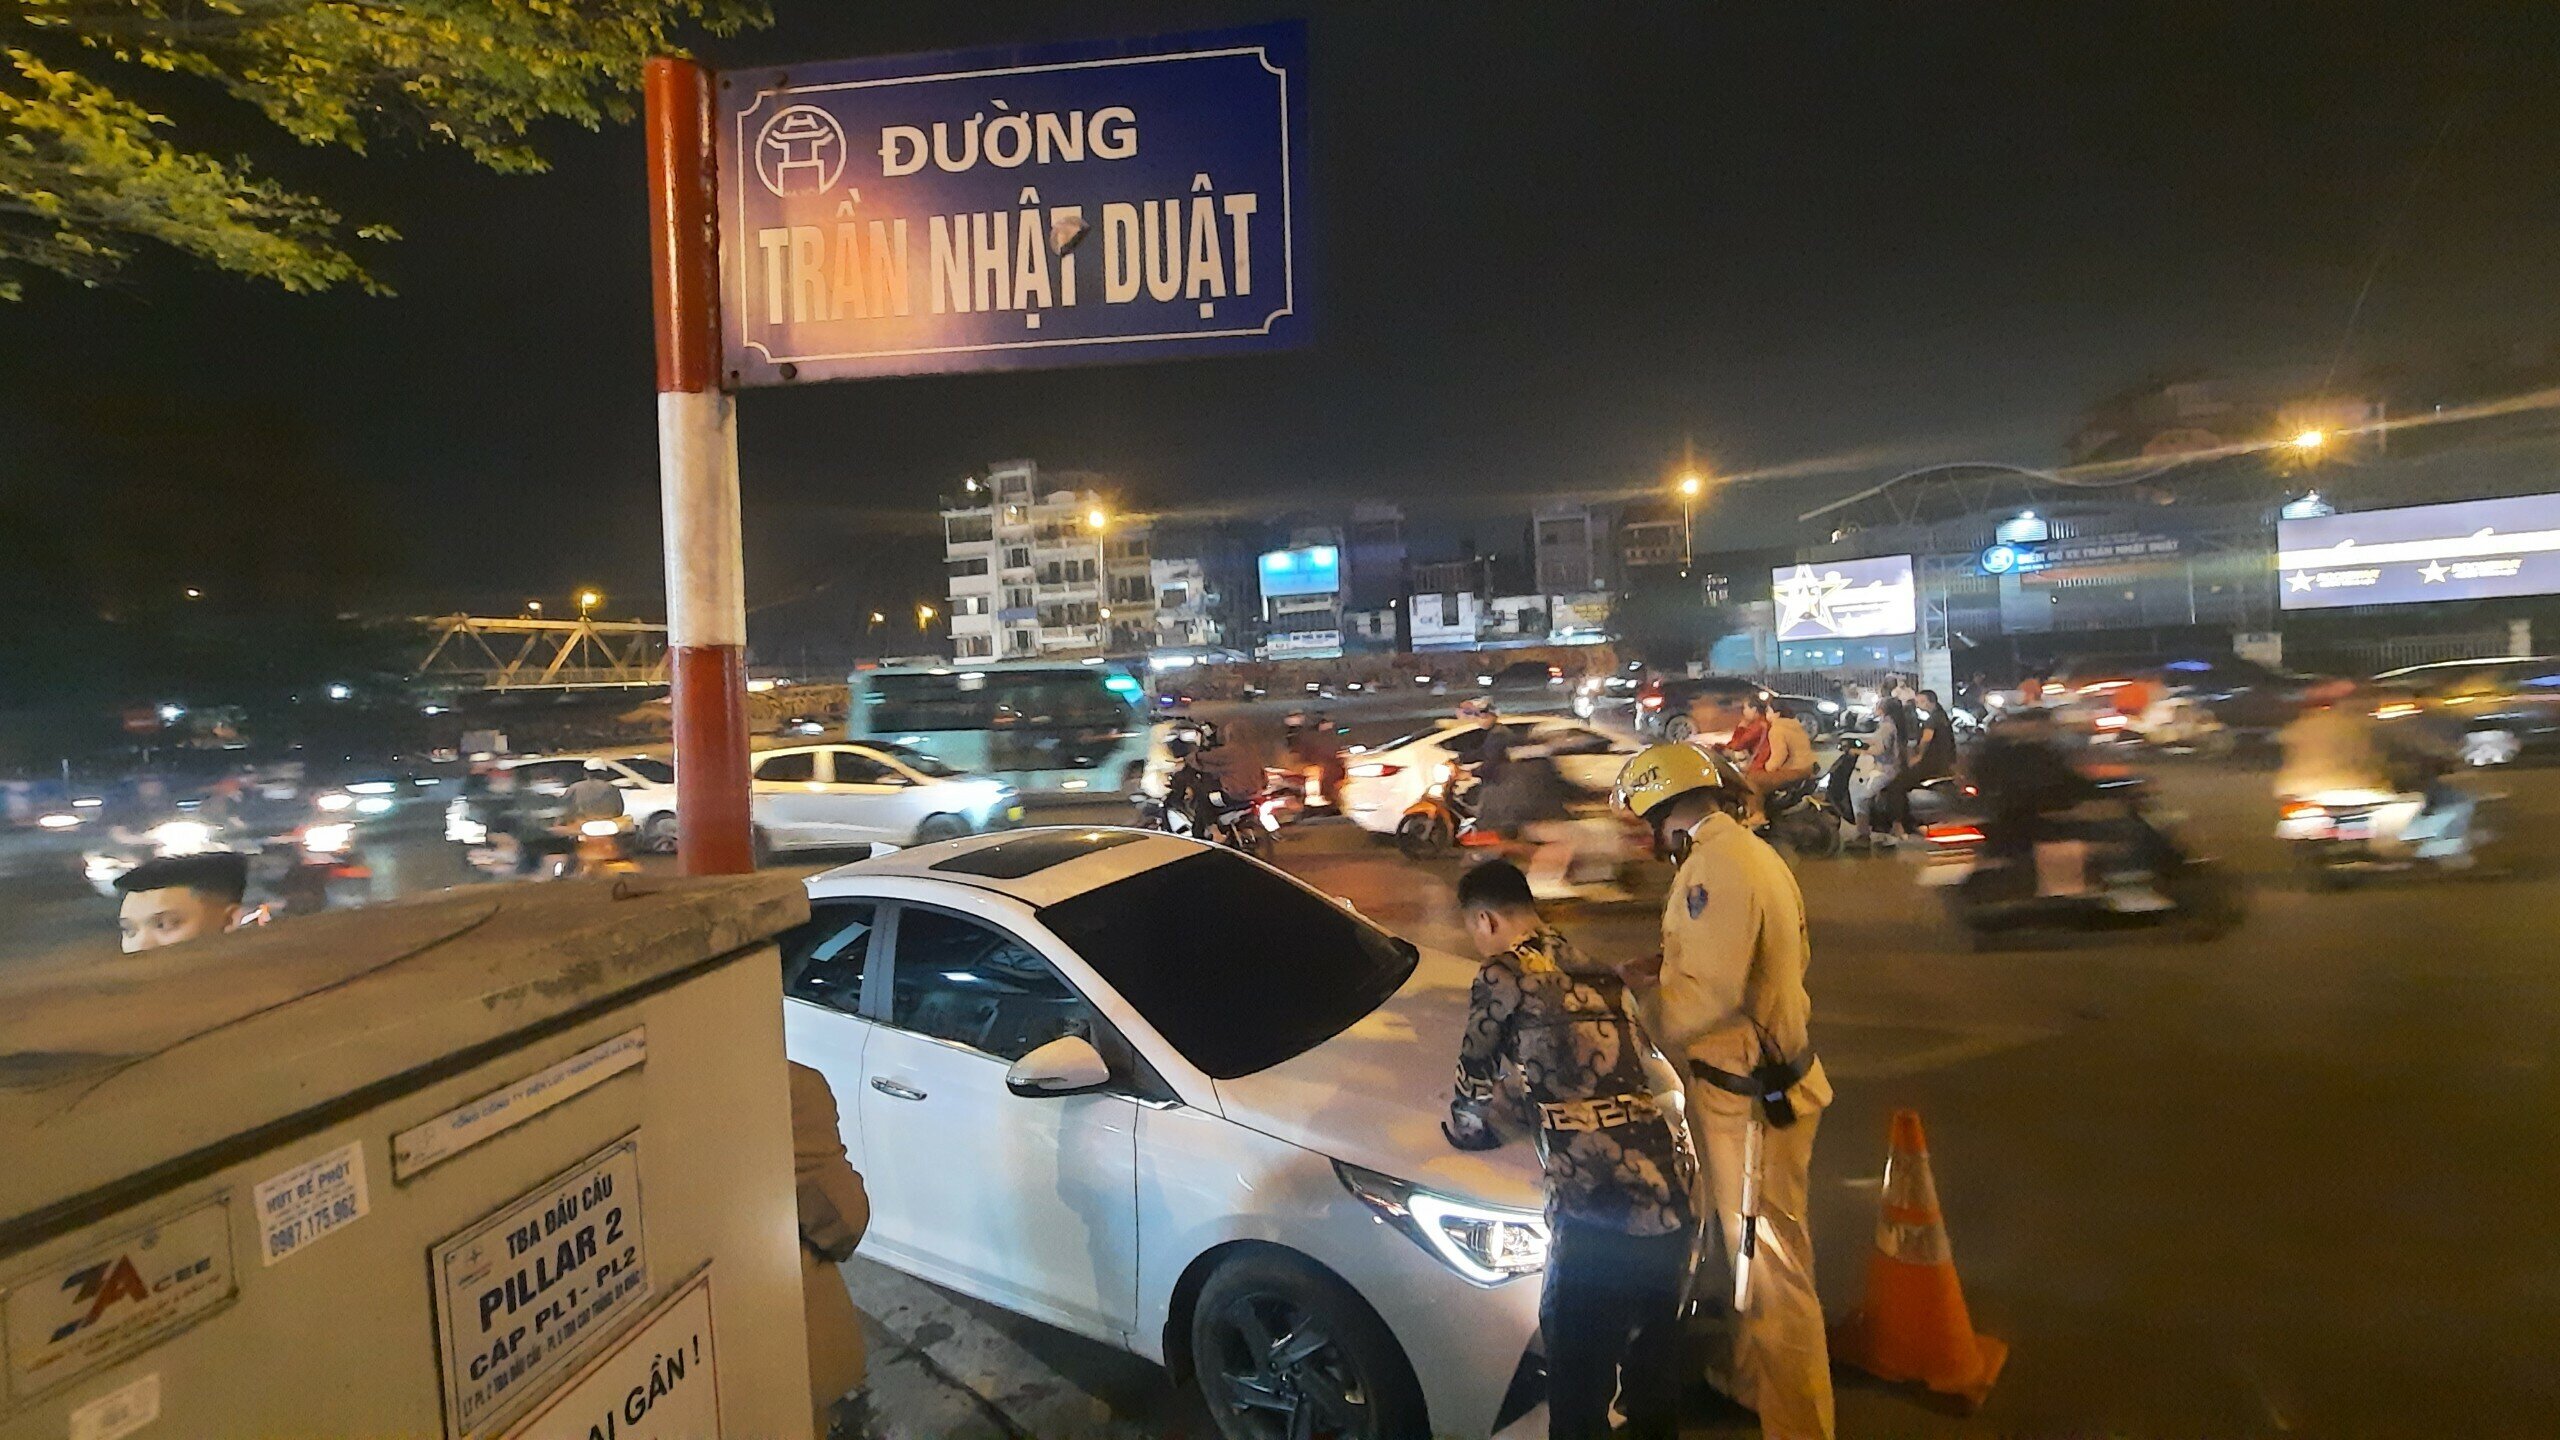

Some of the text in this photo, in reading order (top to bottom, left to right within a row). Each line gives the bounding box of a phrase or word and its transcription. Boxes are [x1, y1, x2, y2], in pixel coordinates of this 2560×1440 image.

[878, 100, 1138, 177] ĐƯỜNG
[759, 173, 1258, 329] TRẦN NHẬT DUẬT
[479, 1207, 624, 1334] PILLAR 2
[506, 1219, 541, 1260] TBA
[470, 1326, 526, 1381] CÁP
[597, 1246, 636, 1288] PL2
[624, 1348, 685, 1426] GẦN
